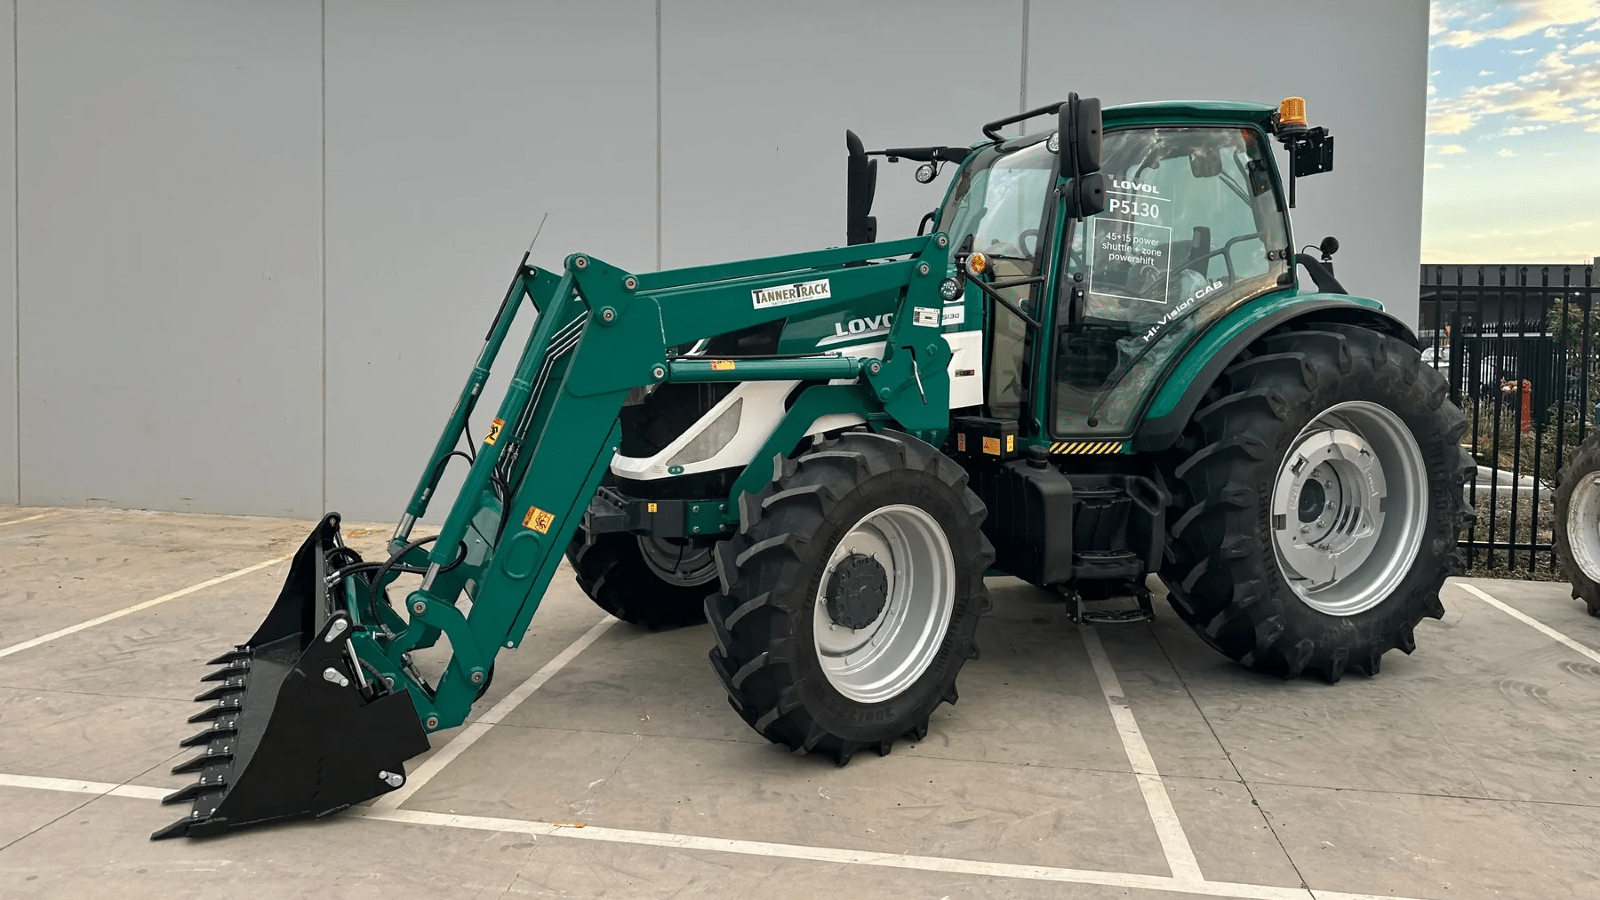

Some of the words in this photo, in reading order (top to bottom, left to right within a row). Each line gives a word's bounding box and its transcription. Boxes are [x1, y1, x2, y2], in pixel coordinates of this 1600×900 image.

[1112, 179, 1160, 194] LOVOL
[1109, 198, 1160, 219] P5130
[1106, 231, 1132, 243] 45+15
[1133, 236, 1160, 246] power
[1101, 241, 1133, 253] shuttle
[1141, 247, 1162, 257] zone
[1108, 253, 1155, 266] powershift
[1195, 280, 1223, 299] CAB
[834, 312, 894, 337] LOVO
